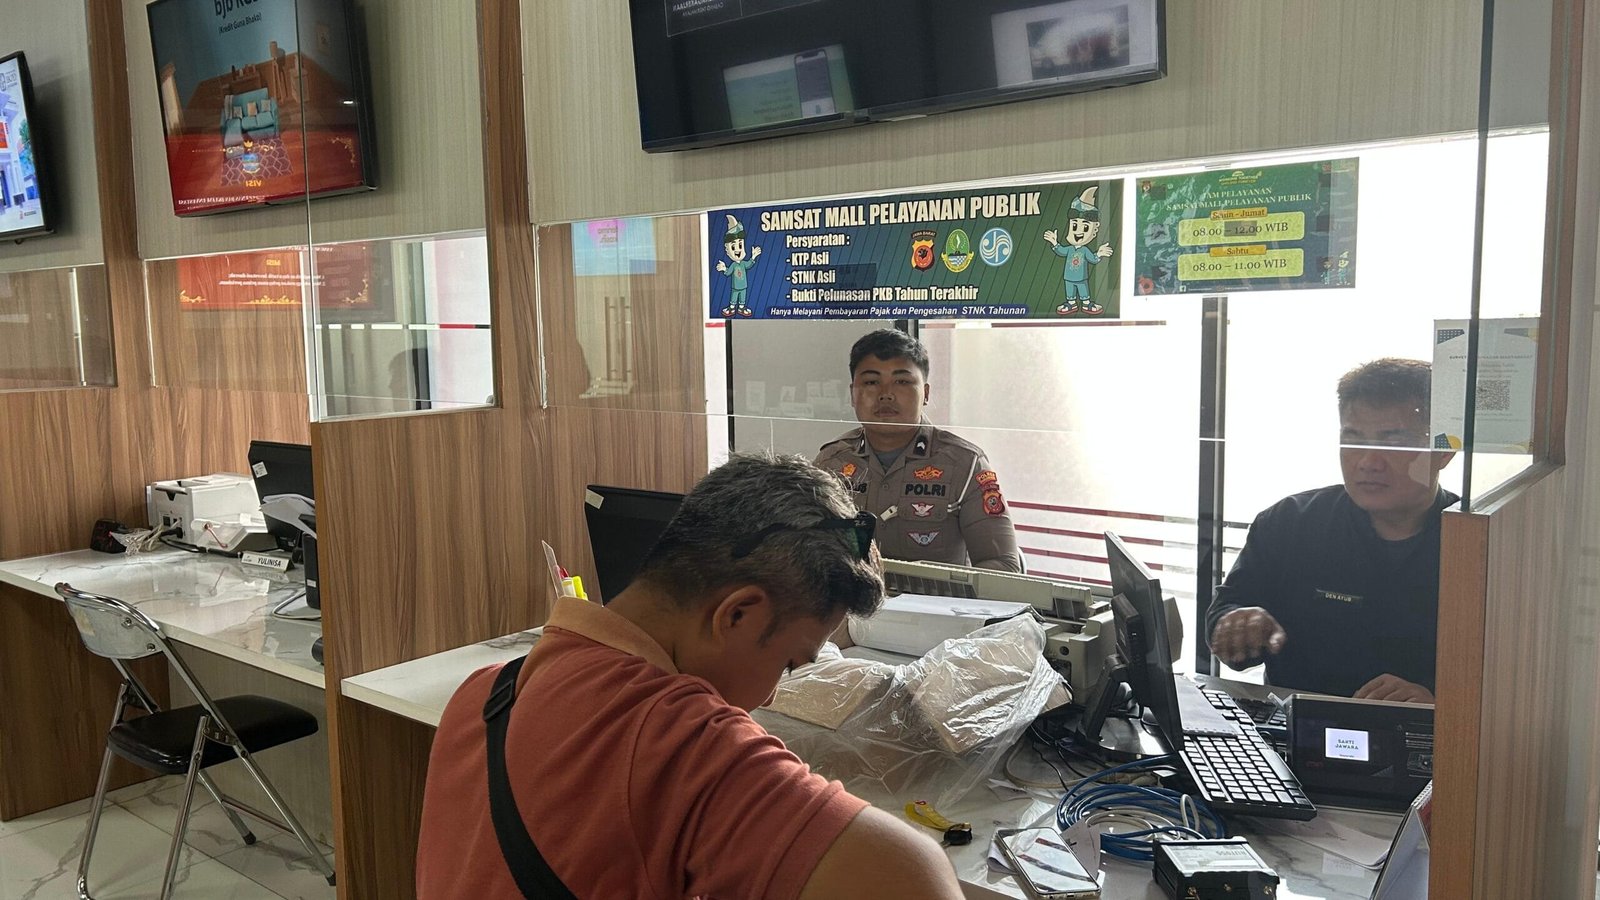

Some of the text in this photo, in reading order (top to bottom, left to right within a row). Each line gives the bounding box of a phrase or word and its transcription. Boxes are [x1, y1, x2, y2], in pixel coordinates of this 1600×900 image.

[1221, 187, 1272, 198] PELAYANAN
[1198, 200, 1222, 208] MALL
[1223, 196, 1276, 206] PELAYANAN
[1278, 194, 1312, 203] PUBLIK
[761, 192, 1040, 232] SAMSAT MALL PELAYANAN PUBLIK
[1240, 209, 1265, 218] Jumat
[1193, 227, 1222, 238] 08.00
[1235, 225, 1262, 234] 12.00
[1266, 222, 1288, 232] WIB
[786, 233, 845, 248] Persyaratan
[792, 252, 810, 266] KTP
[810, 252, 830, 265] Asli
[1193, 262, 1222, 272] 08.00
[1235, 262, 1260, 270] 11.00
[1264, 259, 1287, 268] WIB
[792, 270, 816, 284] STNK
[817, 270, 836, 283] Asli
[792, 288, 816, 302] Bukti
[818, 288, 871, 302] Pelunasan
[872, 288, 893, 301] PKB
[894, 286, 928, 300] Tahun
[930, 286, 978, 300] Terakhir
[771, 306, 1026, 316] Hanya Melayani Pembayaran Pajak dan Pengesahan STNK Tahunan
[904, 484, 946, 497] POLRI
[258, 557, 282, 567] YULINISA
